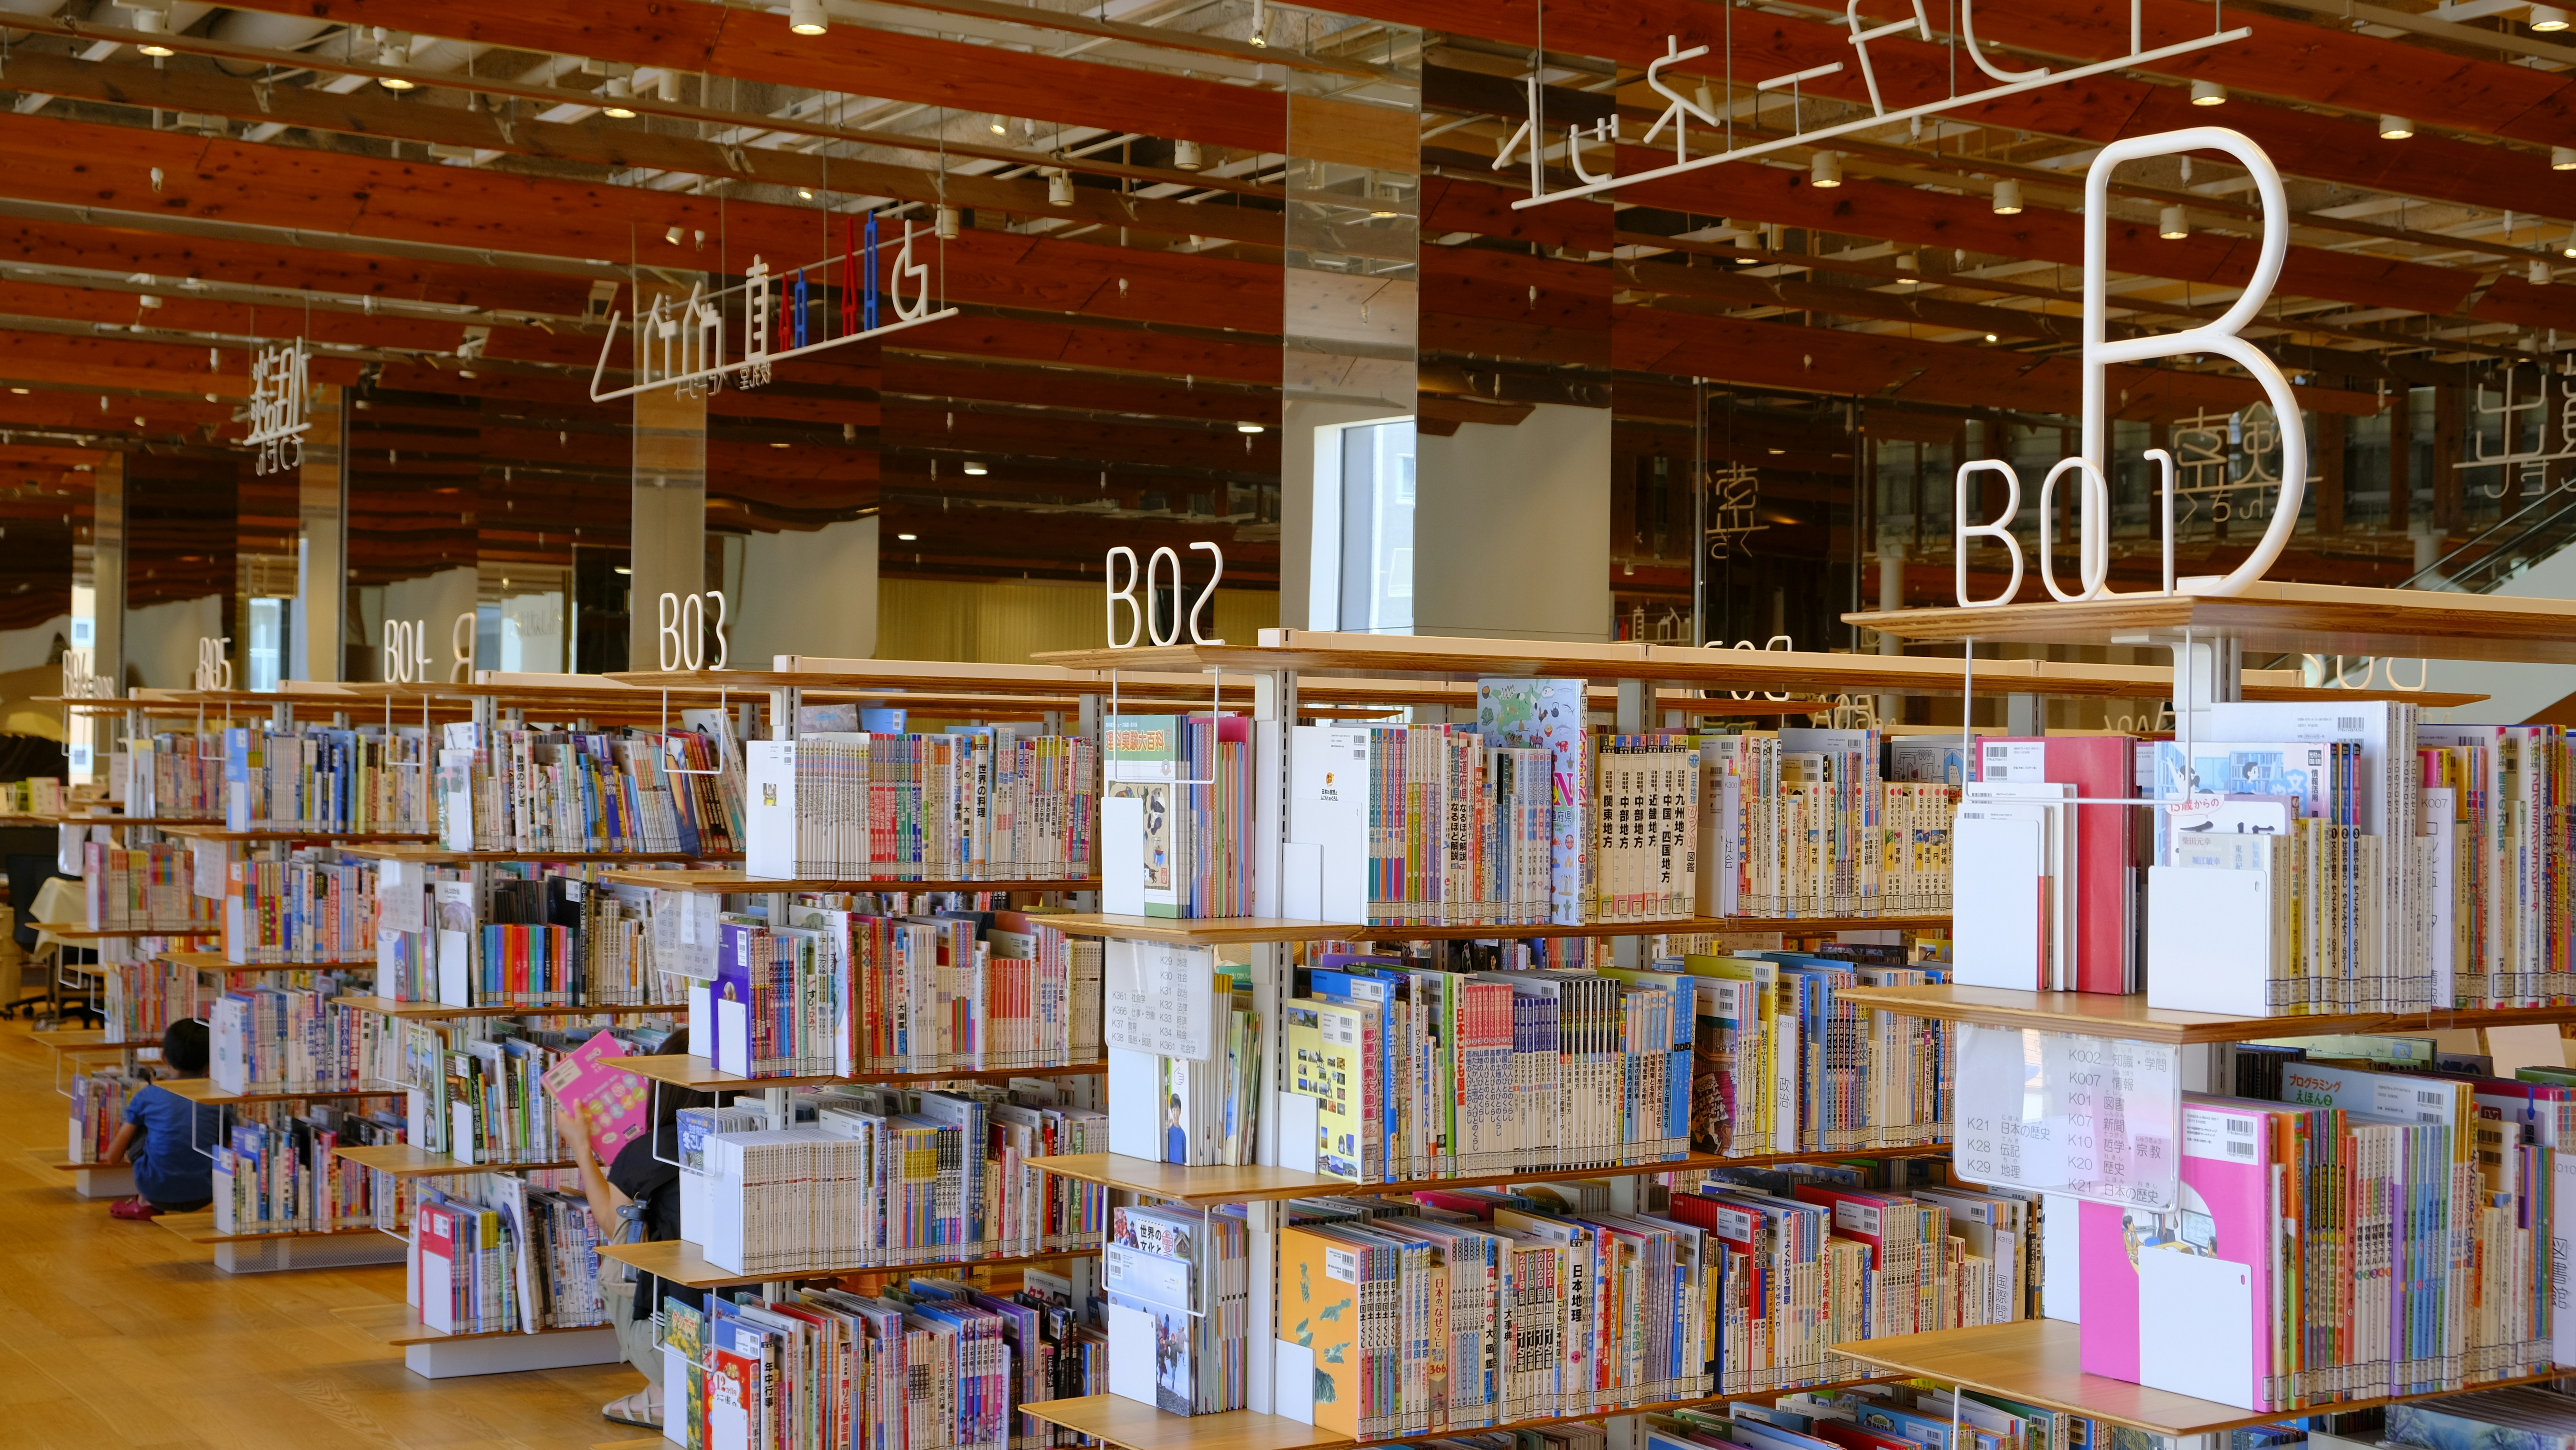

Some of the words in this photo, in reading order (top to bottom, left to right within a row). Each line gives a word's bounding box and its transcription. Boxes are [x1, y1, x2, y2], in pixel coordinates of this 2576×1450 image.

[2081, 126, 2307, 600] B
[1956, 449, 2174, 608] B01
[1106, 541, 1225, 649] B02
[658, 590, 727, 672] B03
[384, 618, 433, 683] B04
[1106, 730, 1165, 751] 理科実験大百科
[1578, 730, 1587, 801] NIPPON
[516, 754, 526, 808] 動物のふしぎ
[977, 764, 986, 817] 世界の料理
[2421, 798, 2448, 808] K007
[1603, 795, 1612, 848] 関東地方
[1619, 796, 1629, 849] 中部地方
[1634, 796, 1643, 848] 中部地方
[1648, 794, 1657, 847] 近畿地方
[1674, 794, 1685, 846] 九州地方
[1662, 794, 1672, 883] 中国・四国地方
[2182, 837, 2211, 845] 柴田元幸
[1812, 848, 1818, 864] 学校
[1829, 848, 1835, 865] 政治
[1895, 848, 1901, 864] 家族
[1925, 848, 1930, 864] 憲法
[1941, 848, 1947, 865] 技術
[2192, 856, 2221, 865] 堀江敏幸
[1160, 956, 1172, 965] K29
[1177, 958, 1187, 967] 地理
[1160, 971, 1172, 980] K30
[1177, 974, 1187, 983] 社会
[1113, 991, 1126, 1000] K361
[1132, 994, 1145, 1003] 社会学
[1160, 986, 1171, 995] K31
[1177, 989, 1187, 998] 政治
[1113, 1006, 1127, 1015] K366
[1132, 1009, 1155, 1020] 仕事・労働
[1160, 1000, 1172, 1010] K32
[1177, 1002, 1187, 1012] 法律
[1112, 1019, 1123, 1028] K37
[1128, 1022, 1136, 1031] 教育
[1160, 1014, 1172, 1023] K33
[1177, 1016, 1187, 1025] 経済
[1112, 1033, 1123, 1042] K38
[1128, 1035, 1151, 1047] 風俗・民話
[1160, 1028, 1171, 1037] K34
[1177, 1030, 1186, 1040] 税金
[1160, 1041, 1175, 1050] K361
[1181, 1044, 1196, 1054] 社会学
[1456, 1009, 1465, 1106] 日本こども図鑑
[2069, 1049, 2101, 1064] K002
[2112, 1053, 2166, 1072] 知識・学問
[1362, 1028, 1377, 1121] 都道府県大図鑑
[2069, 1072, 2101, 1086] K007
[2112, 1076, 2133, 1091] 情報
[2290, 1075, 2342, 1093] プログラミング
[1779, 1077, 1790, 1108] 政治
[2069, 1092, 2091, 1106] K01
[2105, 1097, 2124, 1111] 図書
[2297, 1090, 2323, 1103] えほん
[1968, 1117, 1989, 1131] K21
[2002, 1122, 2050, 1141] 日本の歴史
[2069, 1113, 2092, 1127] K07
[2104, 1118, 2124, 1133] 新聞
[1968, 1138, 1991, 1153] K28
[2001, 1143, 2020, 1158] 伝記
[2068, 1134, 2092, 1148] K10
[2104, 1139, 2160, 1159] 哲学・宗教
[1968, 1159, 1991, 1173] K29
[2001, 1163, 2020, 1179] 地理
[2068, 1156, 2092, 1170] K20
[2104, 1161, 2124, 1176] 歴史
[2068, 1178, 2091, 1192] K21
[2105, 1184, 2158, 1204] 日本の歴史
[1140, 1225, 1162, 1241] 世界の
[1571, 1265, 1582, 1322] 日本地理
[1996, 1274, 2008, 1323] 国際問
[1434, 1279, 1444, 1347] 日本の「なぜ？」に
[1503, 1275, 1513, 1342] 富士山大事典
[1595, 1258, 1605, 1357] 沖縄の大研究
[1485, 1267, 1494, 1369] 富士山の大図鑑
[1517, 1290, 1526, 1372] 日本地理データ年鑑
[1544, 1288, 1553, 1369] 日本地理データ年鑑
[1404, 1341, 1412, 1360] 京都
[1413, 1340, 1421, 1359] 奈良
[1422, 1339, 1429, 1358] 東京
[1429, 1364, 1447, 1374] 366
[765, 1362, 773, 1408] 年中行事
